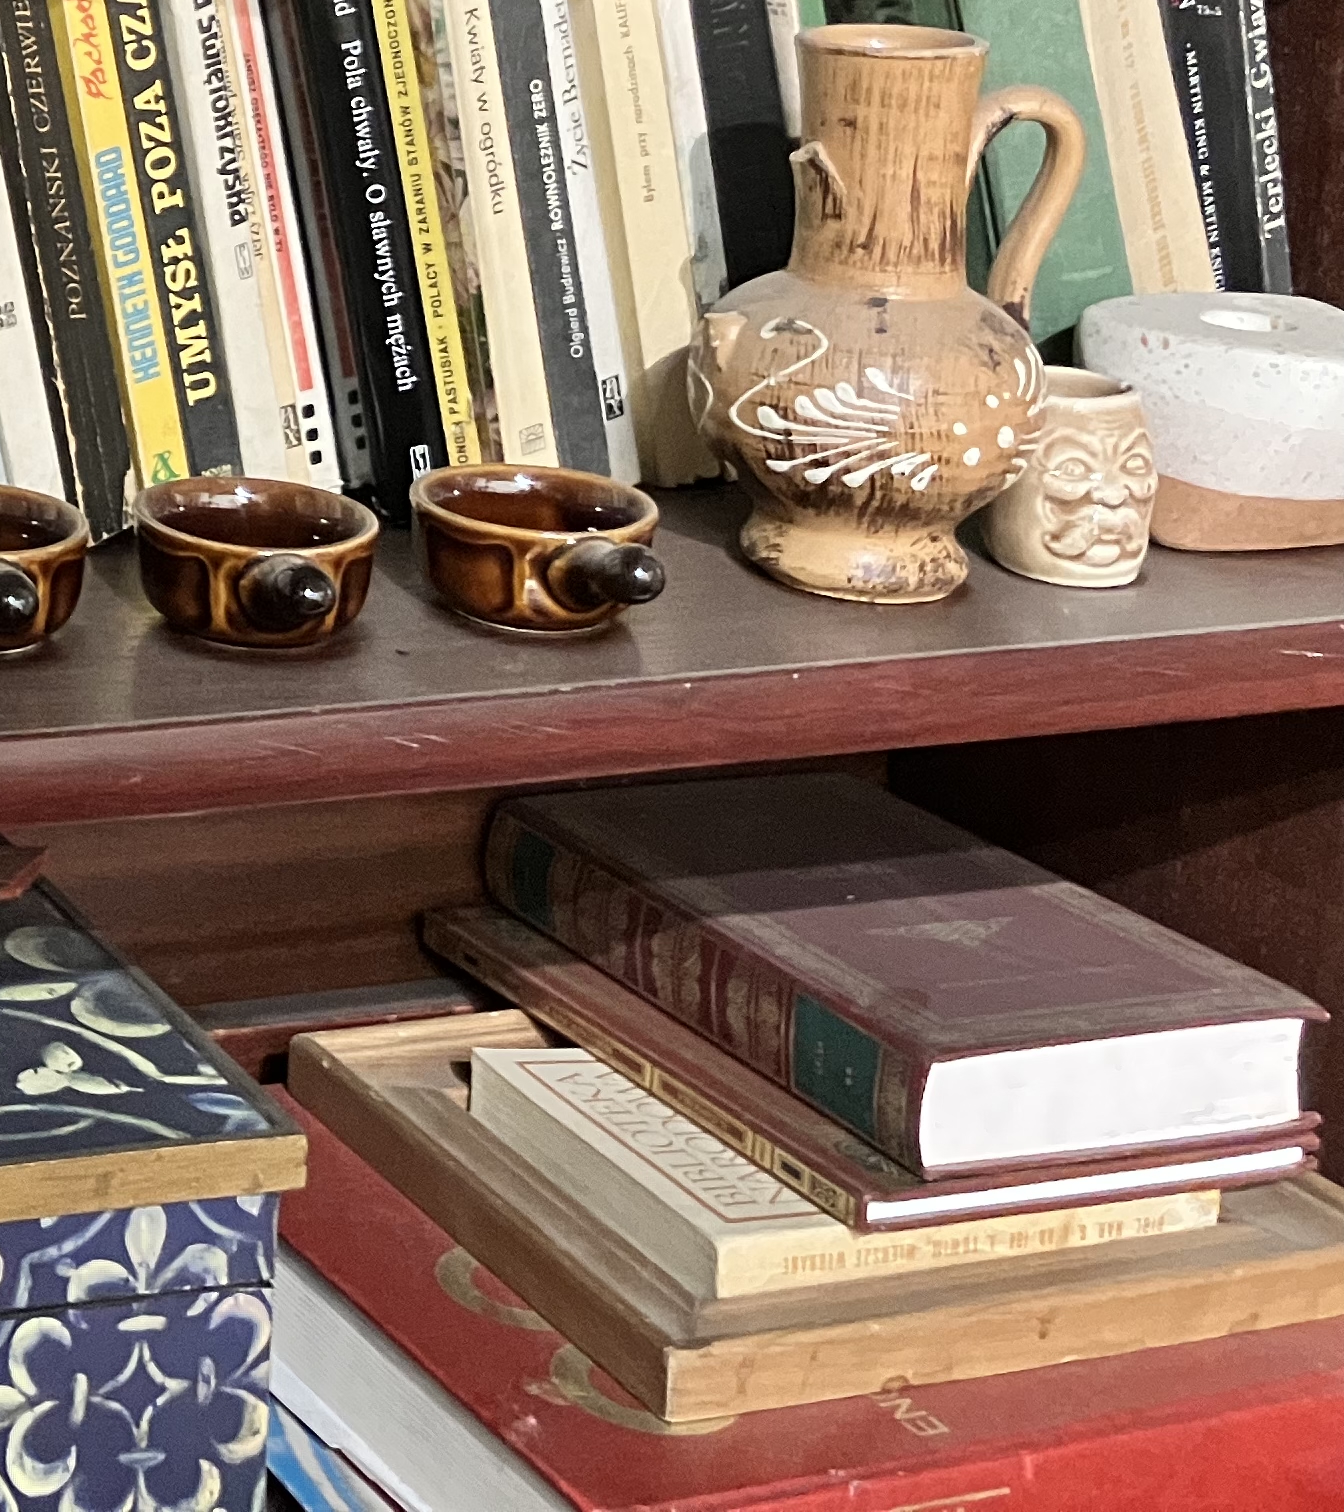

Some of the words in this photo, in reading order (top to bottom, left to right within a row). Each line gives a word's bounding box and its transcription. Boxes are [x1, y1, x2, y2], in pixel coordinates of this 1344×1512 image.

[463, 8, 487, 87] Kwiaty
[476, 91, 489, 114] w
[528, 78, 549, 120] ZERO
[1185, 48, 1205, 116] MARTIN
[132, 79, 185, 215] POZA
[396, 104, 422, 169] STANÓW
[479, 122, 505, 216] ogródku
[564, 110, 591, 177] Życie
[639, 135, 653, 162] przy
[1193, 116, 1209, 161] KING
[409, 173, 432, 236] ZARANIU
[642, 164, 655, 204] Byłem
[1252, 105, 1288, 240] Terlecki
[40, 146, 87, 320] POZNAŃSKI
[94, 146, 141, 268] GODDARD
[340, 39, 363, 91] Pola
[365, 183, 388, 205] O
[385, 313, 421, 393] mężach
[1201, 179, 1217, 245] MARTIN
[421, 242, 433, 257] W
[160, 227, 218, 407] UMYSŁ
[424, 262, 444, 320] POLACY
[562, 316, 585, 360] Olgierd
[438, 335, 461, 416] PASTUSIAK
[555, 1070, 760, 1208] BIBLIOTEKA
